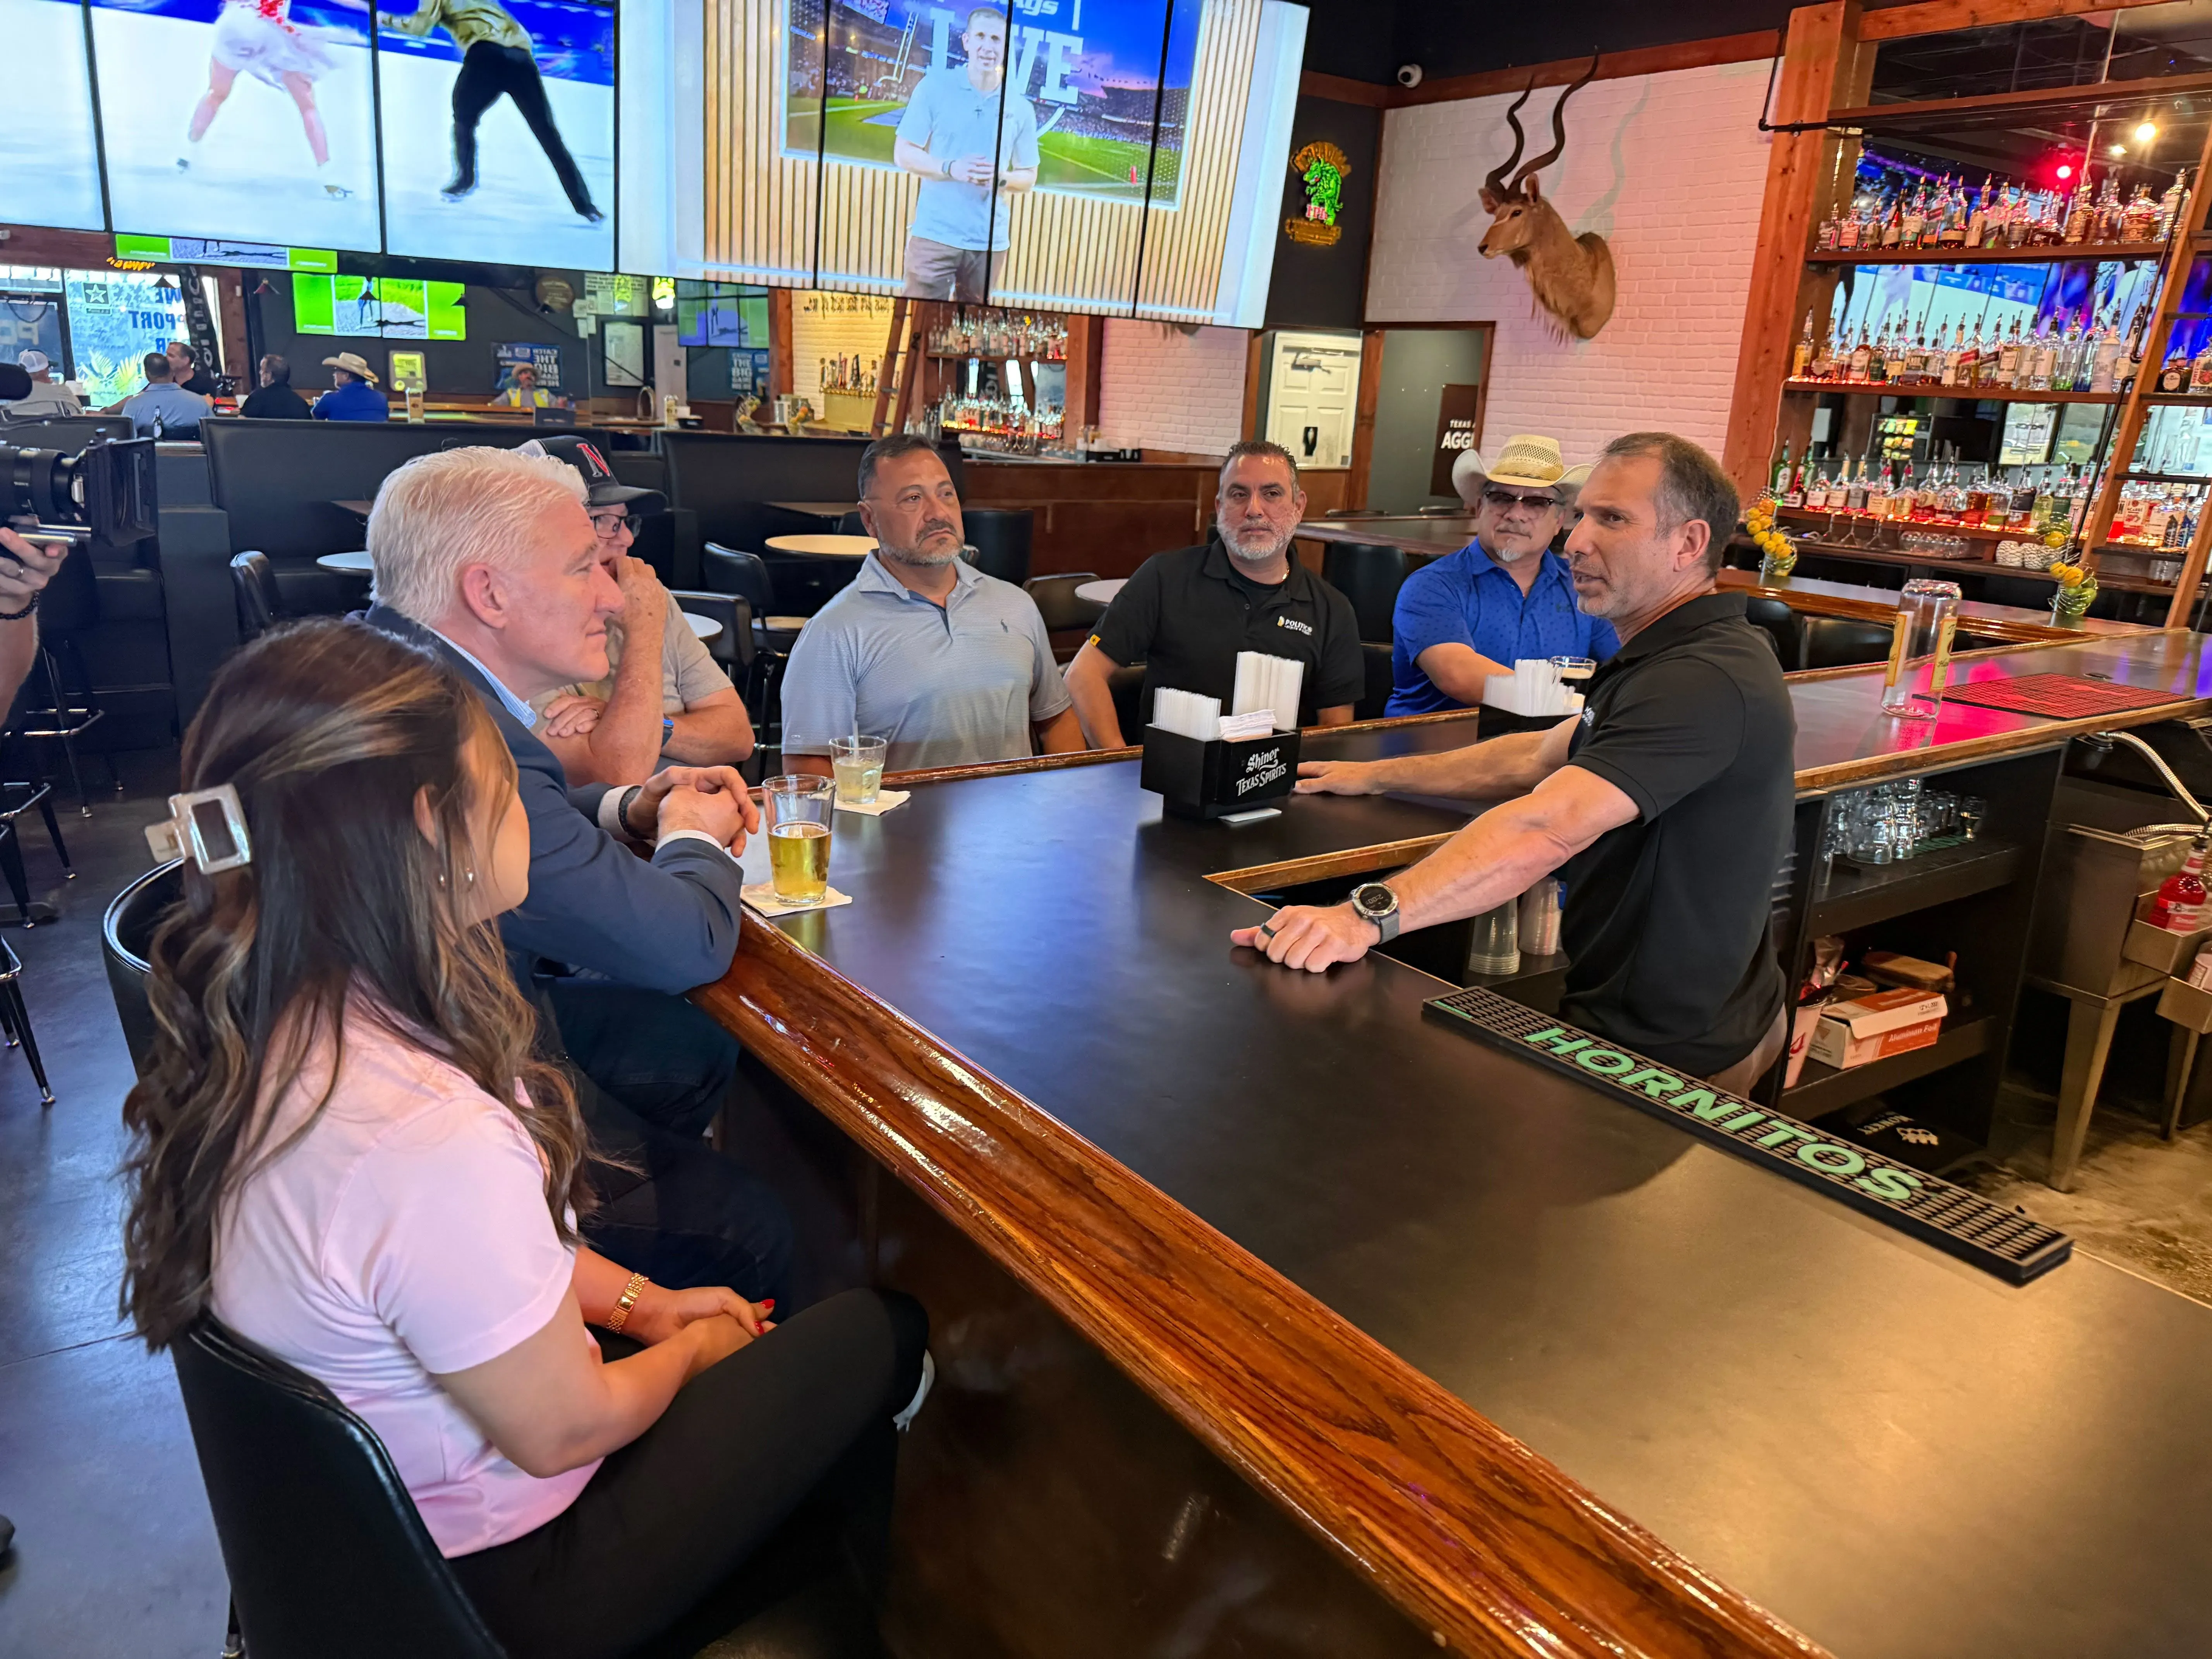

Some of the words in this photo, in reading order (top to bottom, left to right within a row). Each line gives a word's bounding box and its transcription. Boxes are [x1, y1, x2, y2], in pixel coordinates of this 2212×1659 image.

[930, 7, 1084, 105] LVE
[1450, 419, 1472, 428] TEXAS
[1245, 747, 1280, 773] Shiner
[1523, 1027, 1923, 1200] HORNITOS
